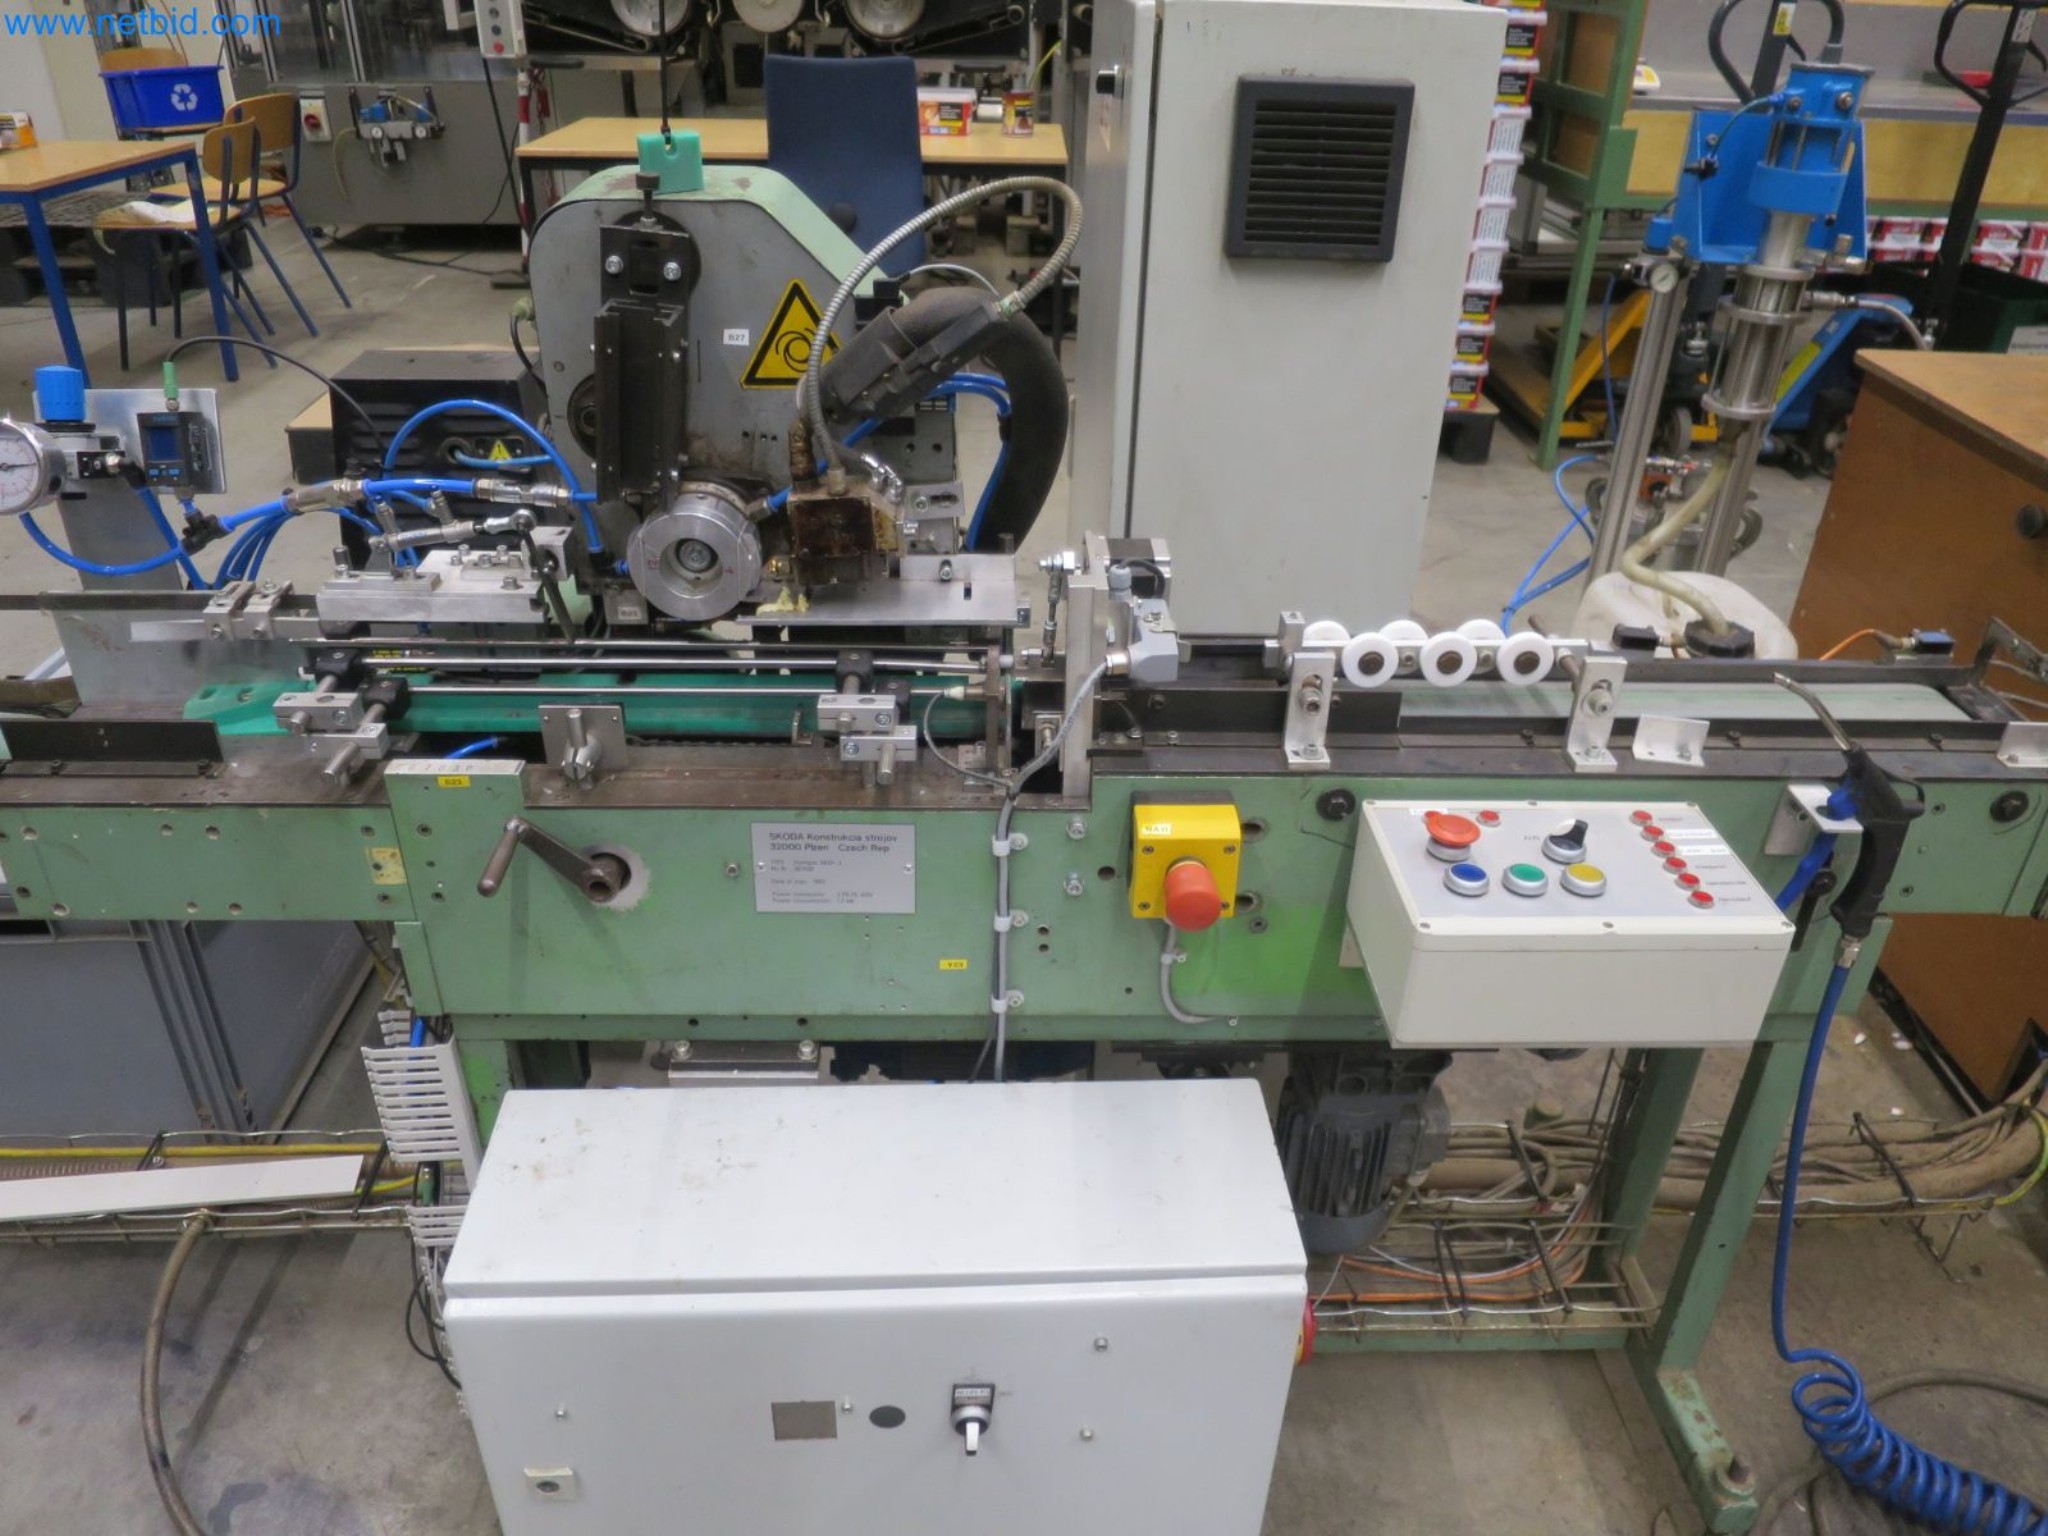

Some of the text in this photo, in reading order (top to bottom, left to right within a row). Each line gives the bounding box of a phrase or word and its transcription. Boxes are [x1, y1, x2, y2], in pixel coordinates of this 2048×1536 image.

[768, 832, 805, 841] SKODA
[865, 834, 898, 844] strojov
[769, 842, 802, 851] 32000
[838, 843, 868, 852] Czech
[870, 844, 890, 853] Rep
